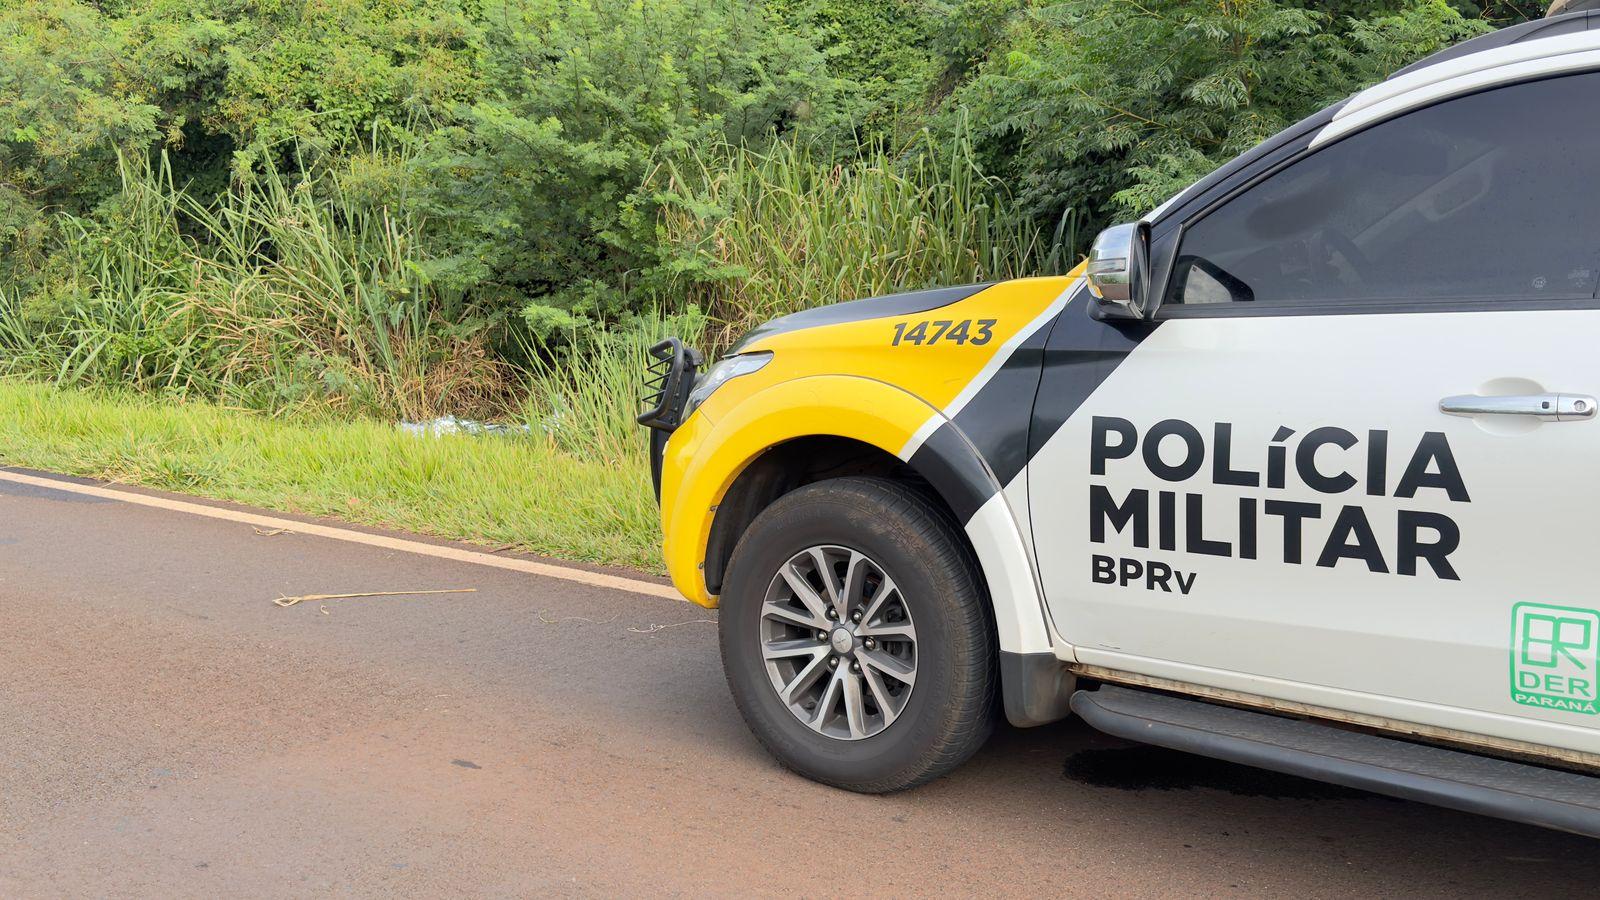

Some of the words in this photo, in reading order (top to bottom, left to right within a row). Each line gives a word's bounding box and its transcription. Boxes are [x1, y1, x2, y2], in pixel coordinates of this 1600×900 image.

[892, 319, 998, 346] 14743
[1090, 485, 1461, 581] MILITAR
[1092, 555, 1197, 595] BPRv
[1519, 671, 1592, 697] DER
[1515, 693, 1597, 713] PARANÁ
